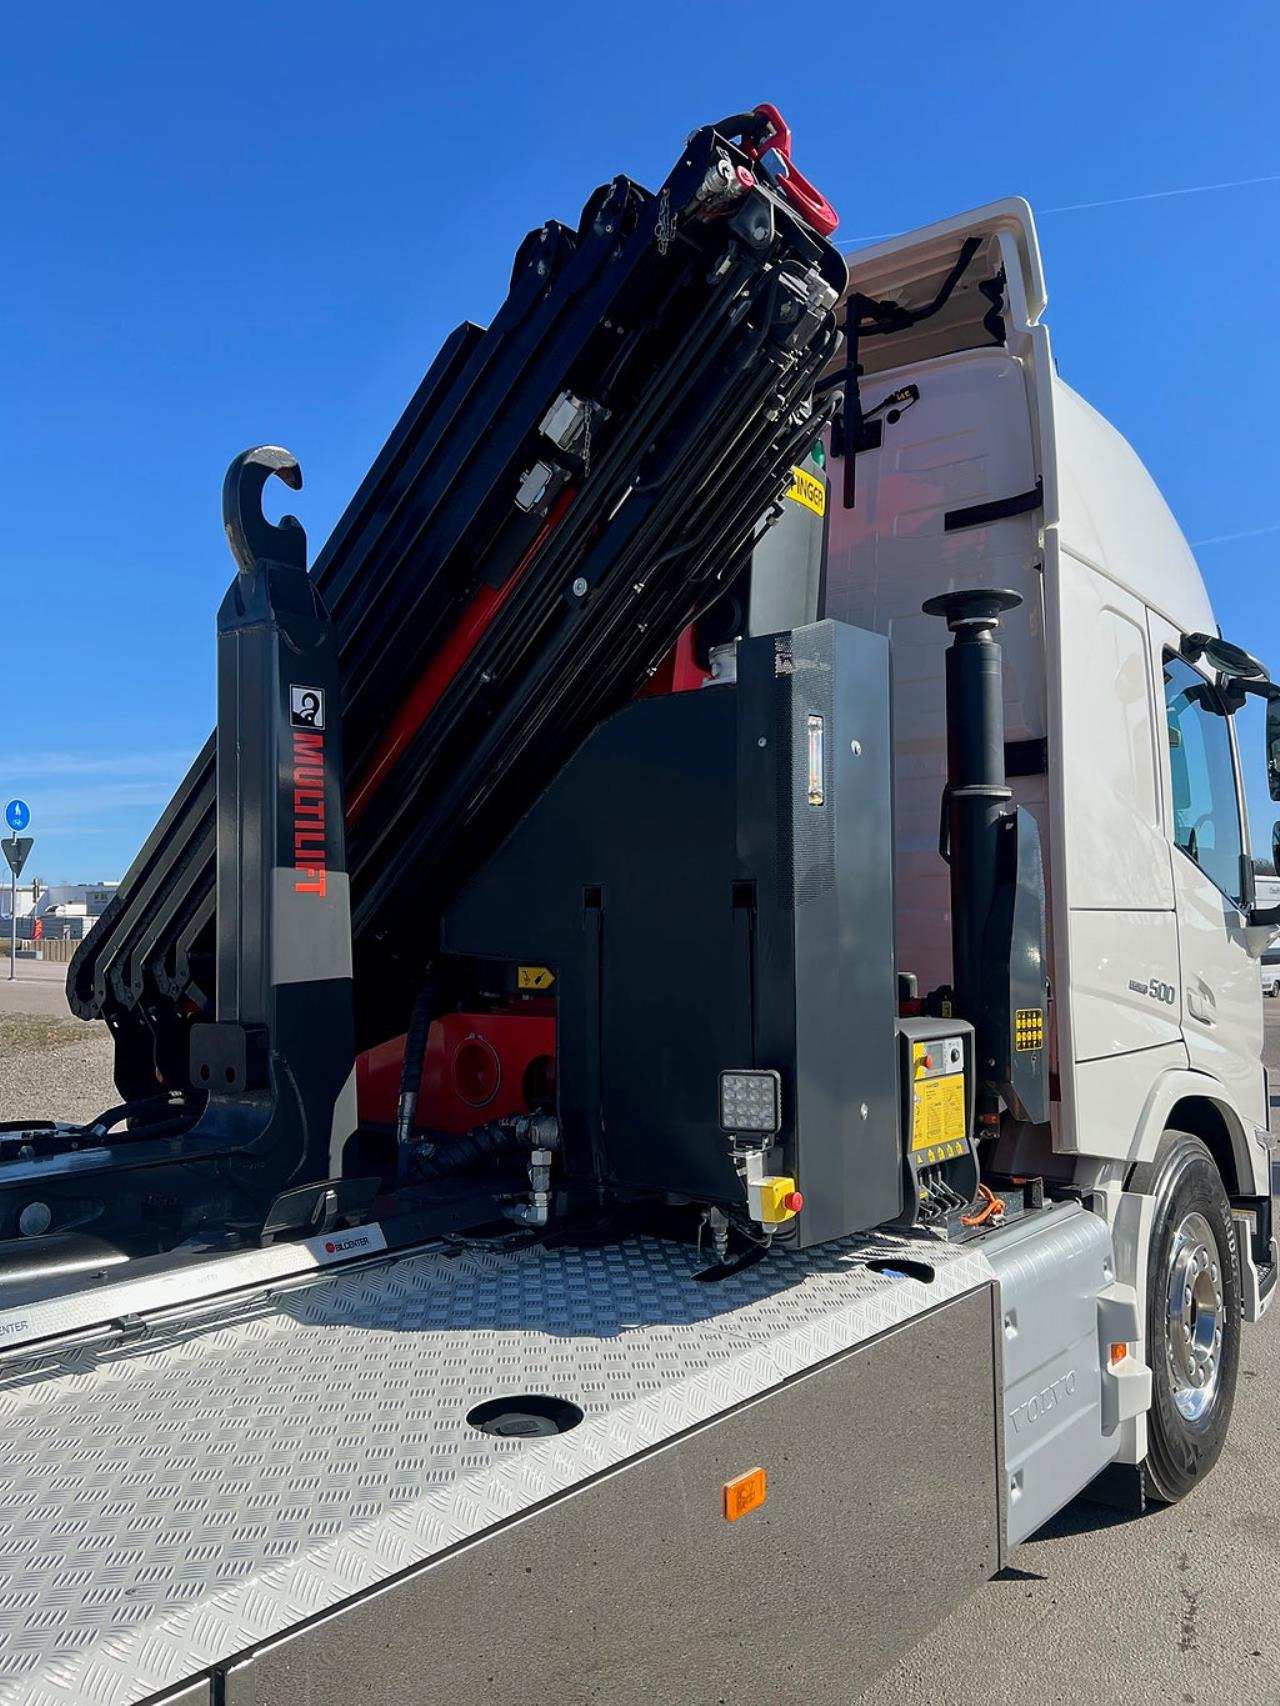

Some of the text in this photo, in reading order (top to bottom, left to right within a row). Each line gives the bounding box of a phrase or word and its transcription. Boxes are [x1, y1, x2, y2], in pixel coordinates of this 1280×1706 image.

[292, 732, 327, 897] MULTILIFT
[1149, 978, 1176, 1006] 500
[335, 1236, 369, 1252] BILCENTER
[1009, 1369, 1077, 1434] VOLVO
